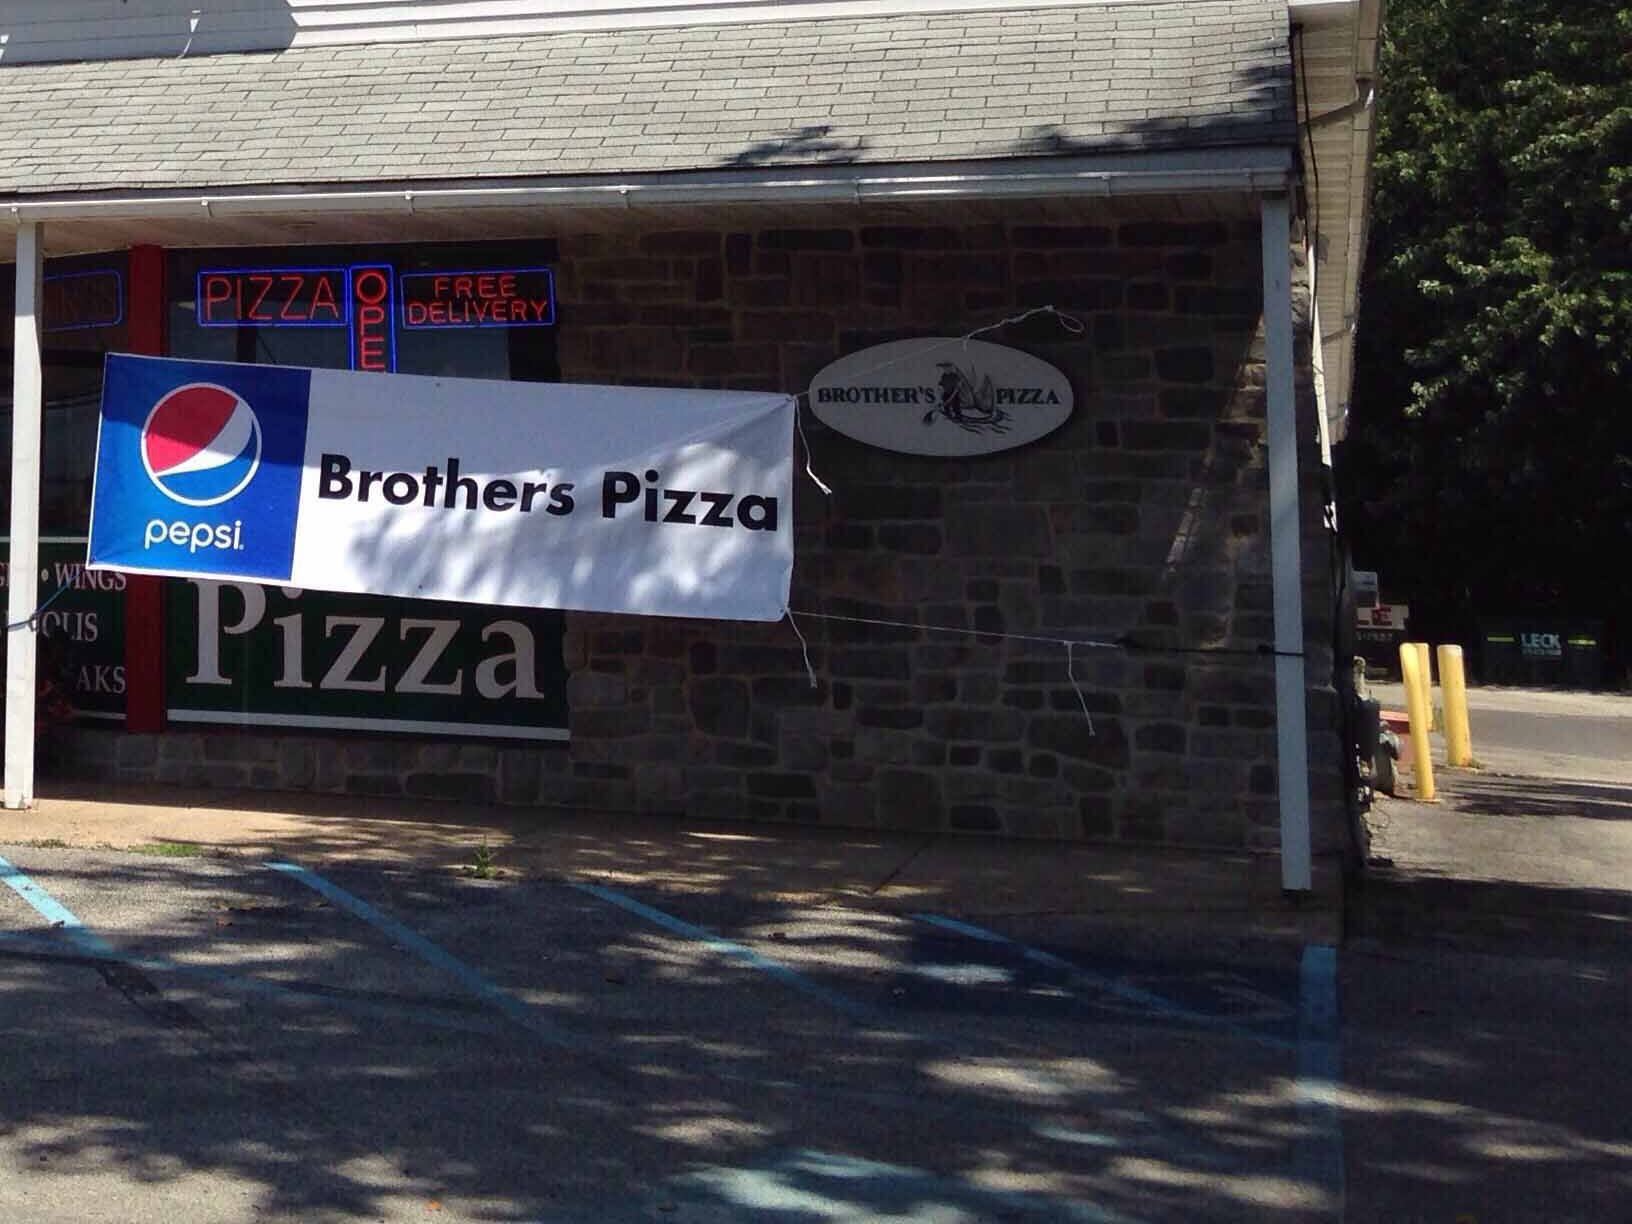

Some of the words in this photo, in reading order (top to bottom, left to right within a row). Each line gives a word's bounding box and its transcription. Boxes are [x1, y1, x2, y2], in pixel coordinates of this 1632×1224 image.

[204, 275, 340, 321] PIZZA
[434, 274, 518, 299] FREE
[356, 270, 387, 373] OPE
[407, 298, 548, 325] DELIVERY
[817, 385, 936, 406] BROTHER'S
[995, 387, 1060, 406] PIZZA
[318, 453, 574, 516] Brothers
[602, 468, 779, 532] Pizza
[144, 517, 242, 554] pepsi
[55, 563, 127, 591] WINGS
[185, 578, 545, 702] Pizza
